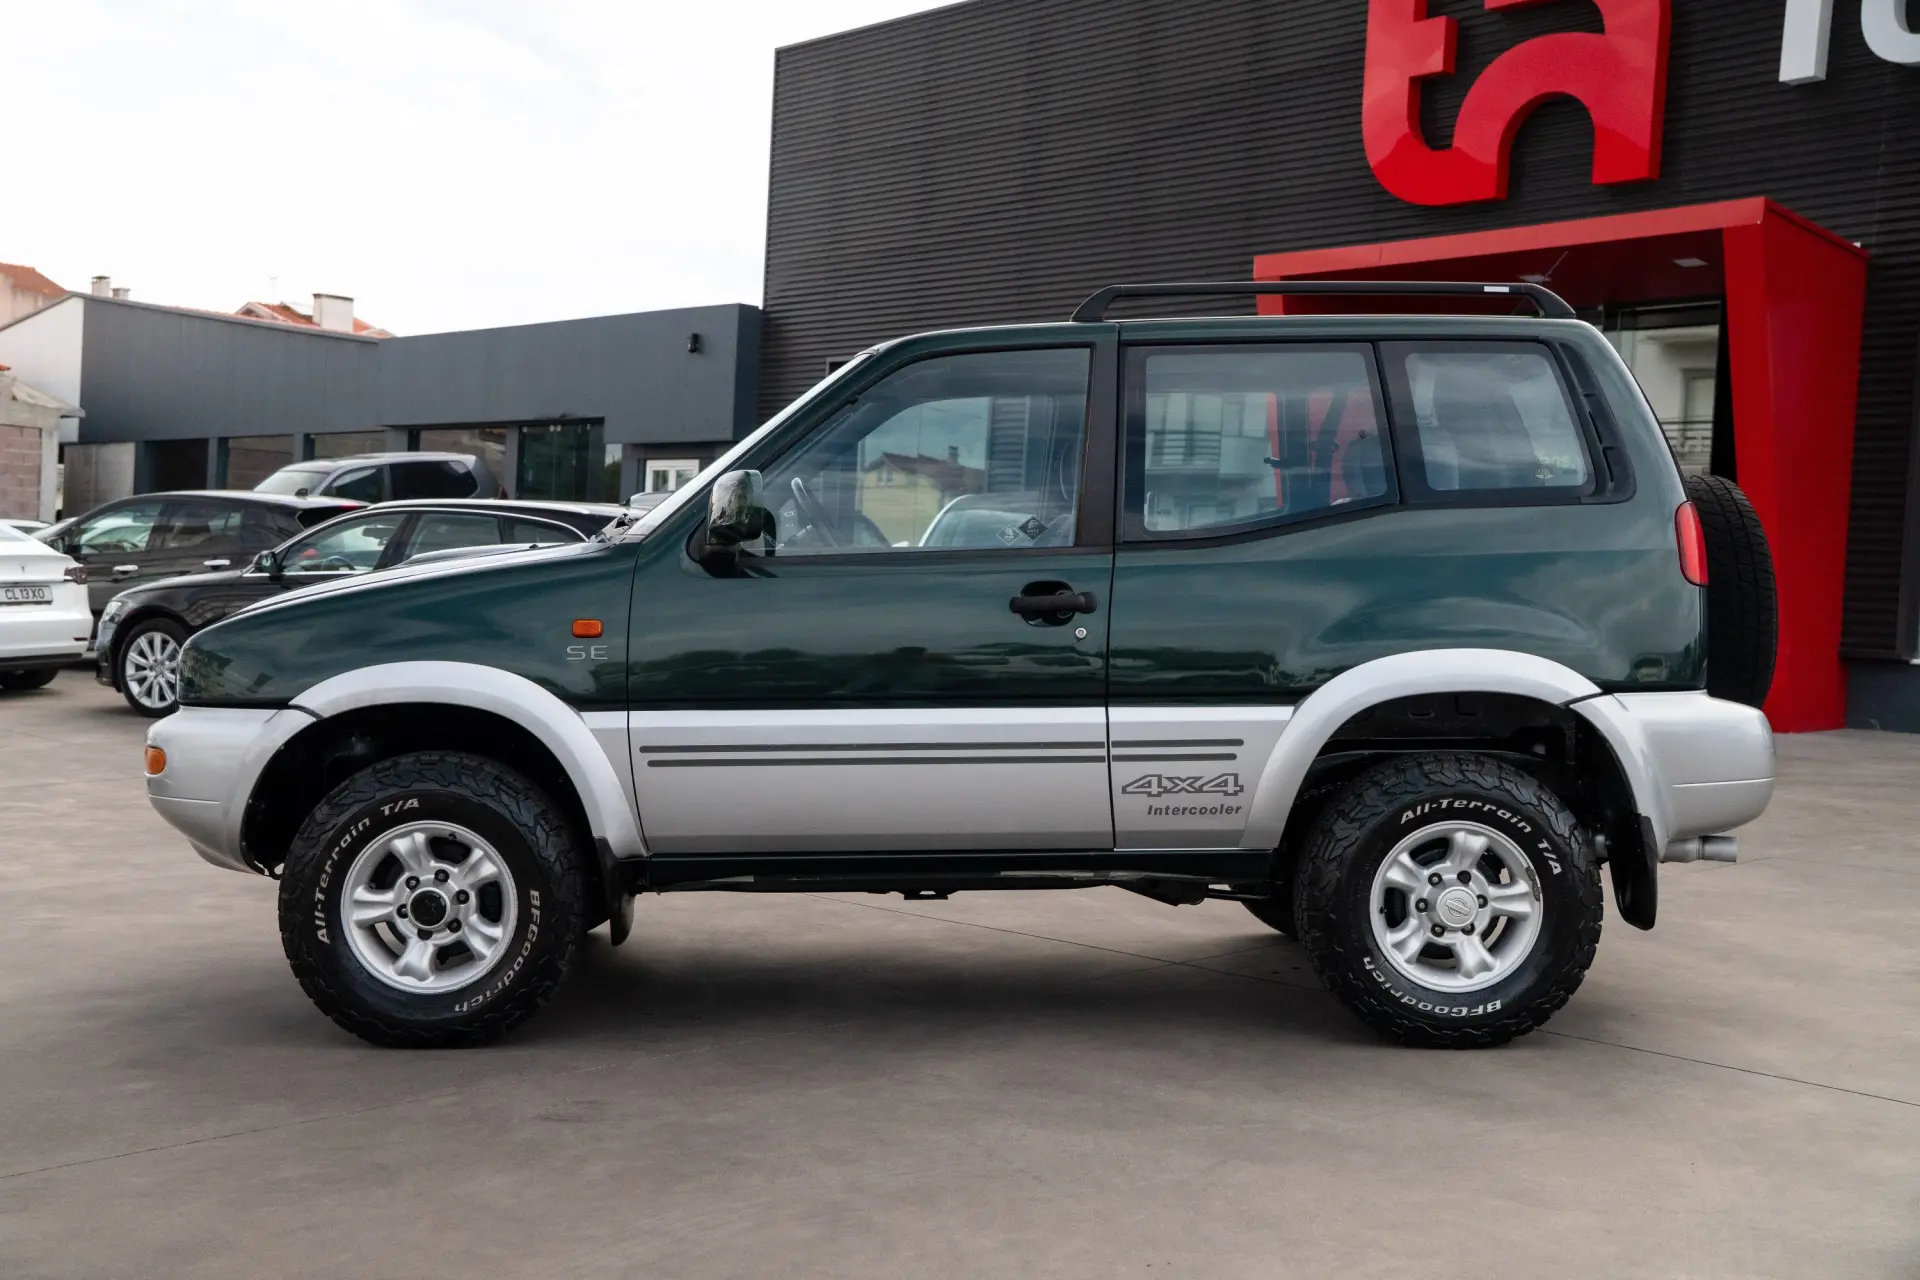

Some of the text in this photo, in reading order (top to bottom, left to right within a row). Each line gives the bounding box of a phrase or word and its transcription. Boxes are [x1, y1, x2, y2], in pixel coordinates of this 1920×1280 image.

[4, 588, 19, 600] CL
[20, 588, 30, 600] 13
[566, 645, 609, 660] SE
[1147, 804, 1242, 816] Intercooler
[1400, 798, 1563, 875] All-Terrain T/A
[314, 798, 420, 945] All-Terrain T/A
[455, 889, 541, 1012] BFGoodrich
[1363, 956, 1502, 1017] BFGoodrich
